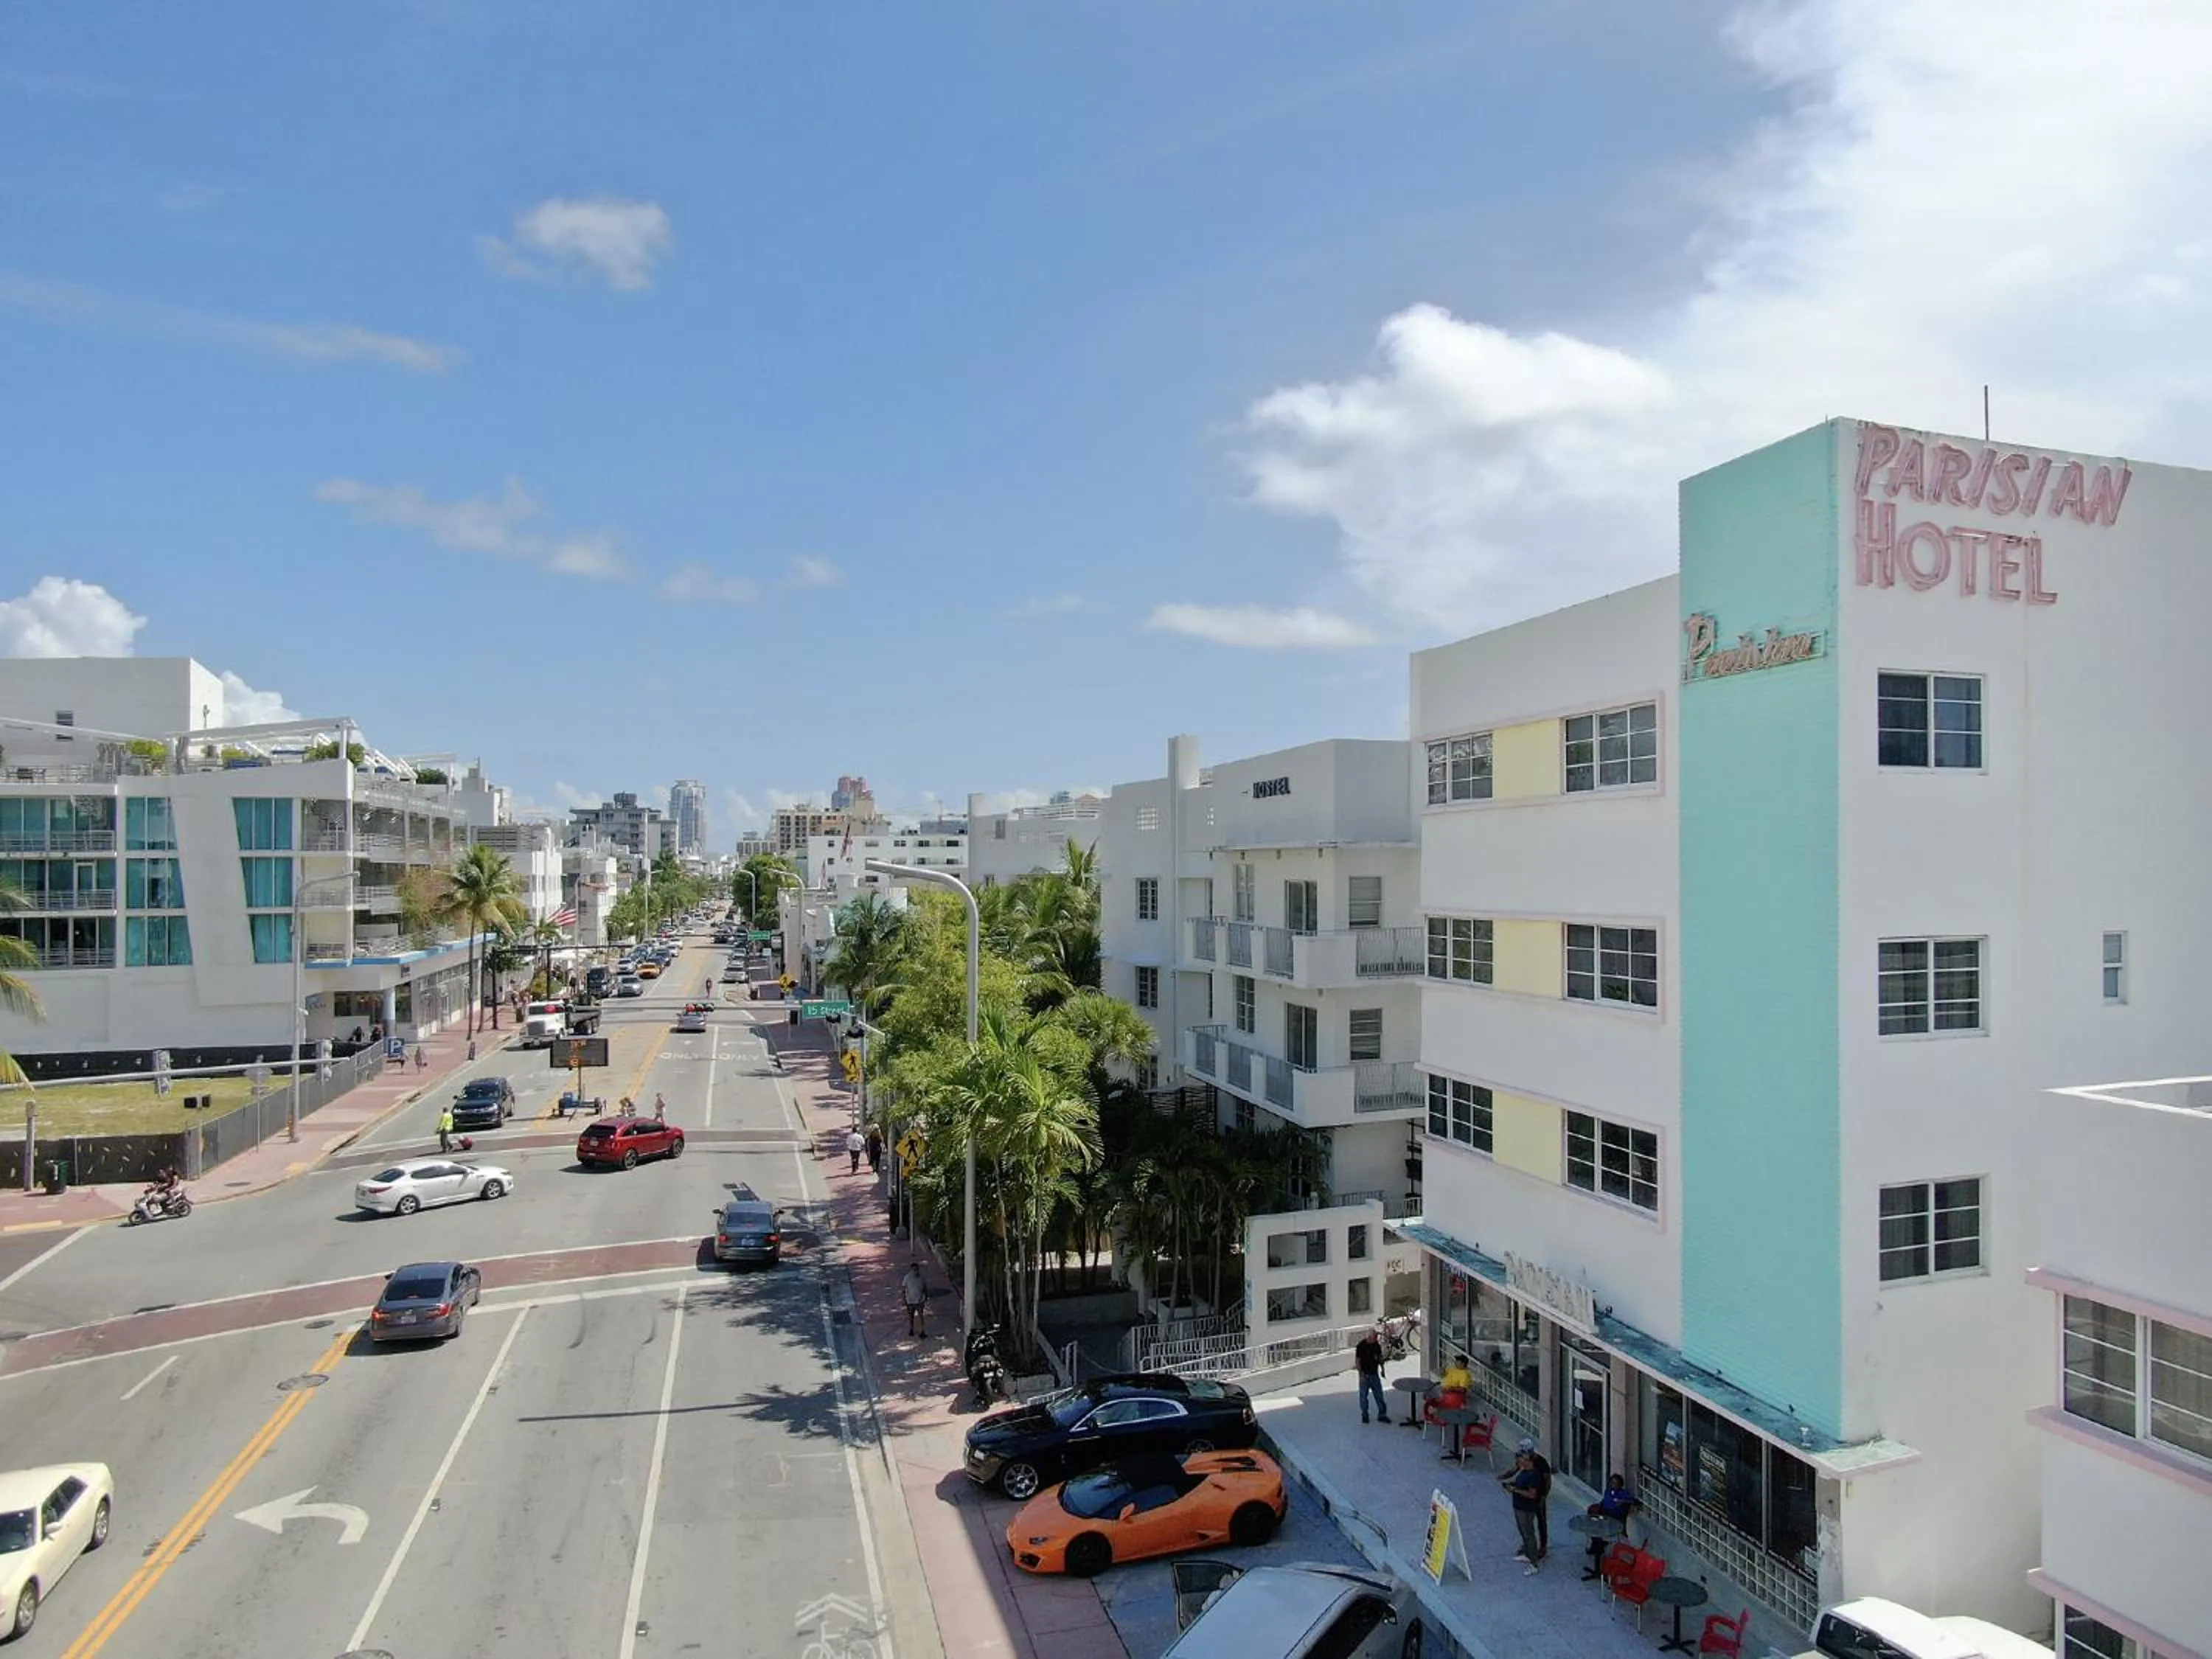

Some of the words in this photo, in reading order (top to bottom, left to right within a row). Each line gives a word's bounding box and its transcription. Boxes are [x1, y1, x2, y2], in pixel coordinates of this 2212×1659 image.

[1854, 422, 2133, 527] PARISIAN
[1854, 498, 2058, 605] HOTEL
[807, 1005, 818, 1015] 15
[390, 1040, 403, 1055] P
[659, 1051, 700, 1060] ONLY
[718, 1053, 759, 1061] ONLY
